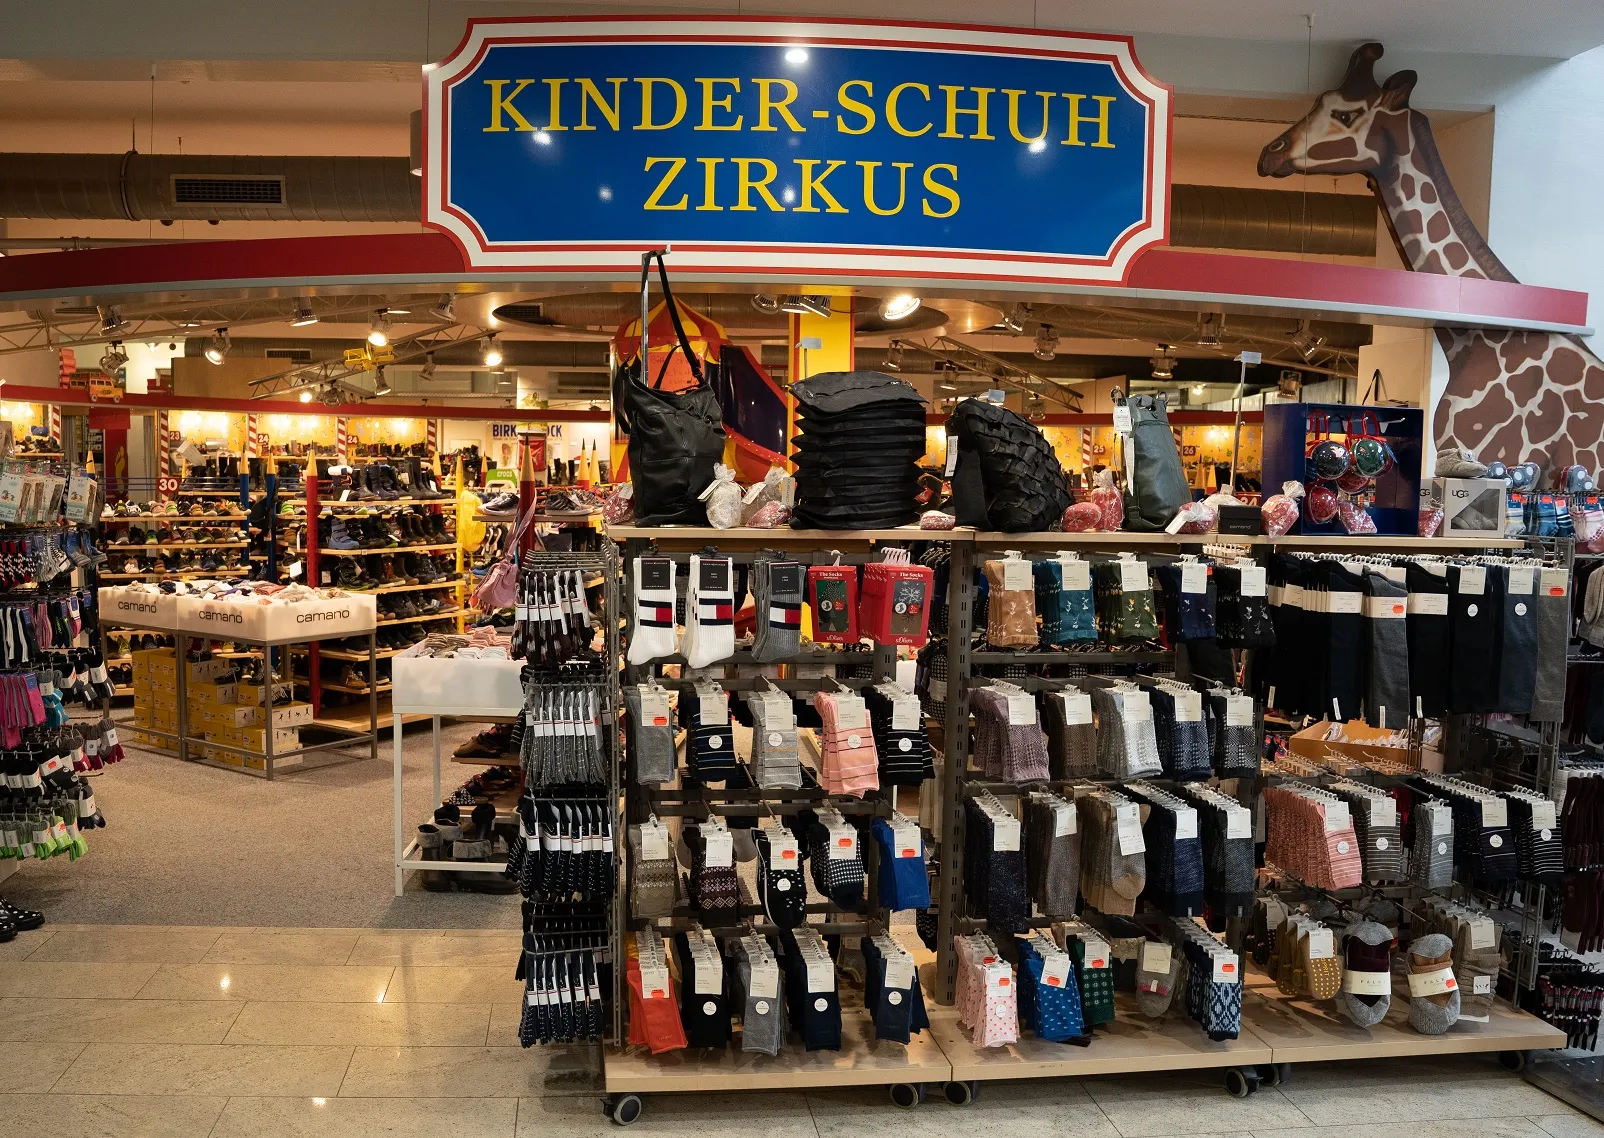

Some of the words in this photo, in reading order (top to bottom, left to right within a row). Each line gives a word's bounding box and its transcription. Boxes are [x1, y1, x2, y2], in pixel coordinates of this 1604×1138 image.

[482, 76, 1117, 150] KINDER-SCHUH
[643, 156, 962, 219] ZIRKUS
[170, 430, 180, 440] 23
[258, 434, 269, 443] 24
[347, 435, 358, 444] 24
[1093, 445, 1104, 453] 25
[1184, 446, 1194, 455] 26
[496, 470, 513, 478] crocs
[158, 479, 178, 491] 30
[1451, 489, 1470, 499] UGG
[118, 600, 157, 614] camano
[198, 609, 243, 624] camano
[296, 608, 350, 624] camano
